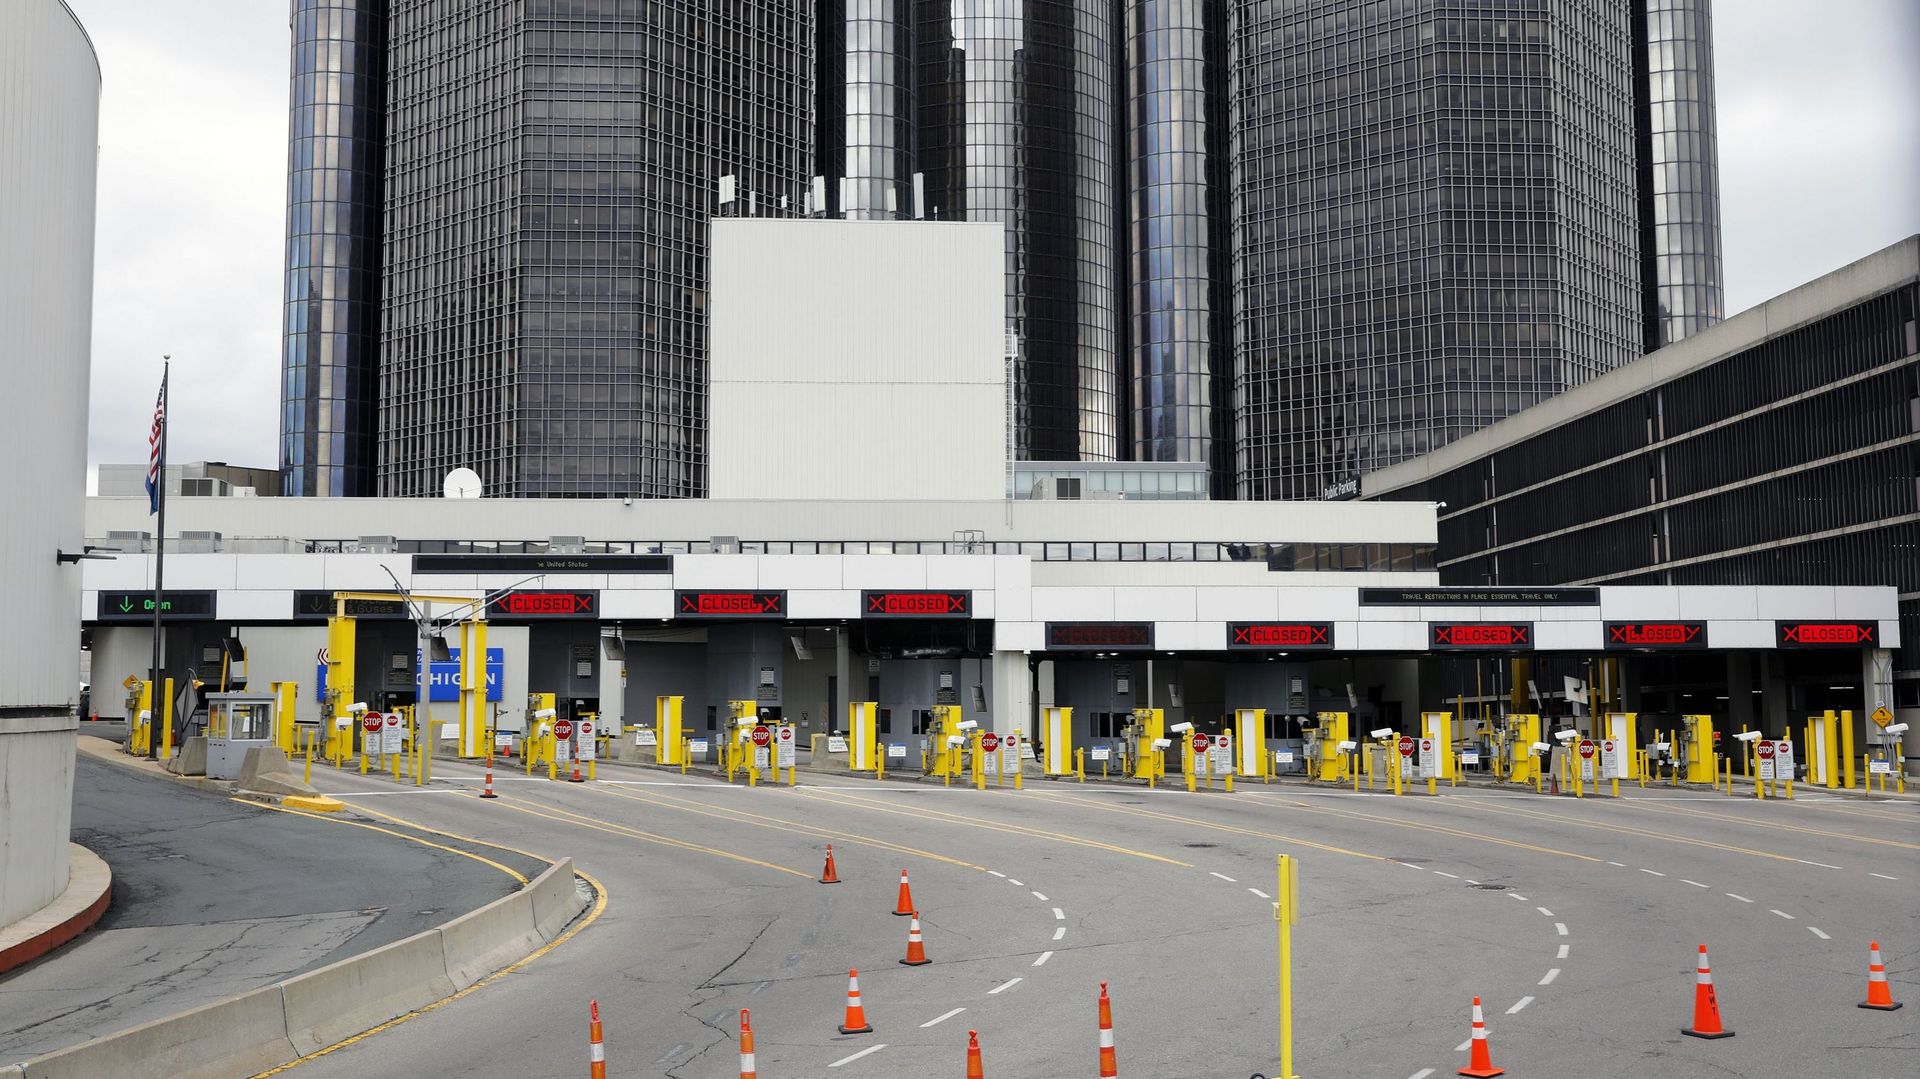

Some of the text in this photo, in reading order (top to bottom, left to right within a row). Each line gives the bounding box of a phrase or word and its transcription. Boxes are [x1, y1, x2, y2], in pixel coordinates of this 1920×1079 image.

[1324, 479, 1356, 500] Public Parking
[513, 598, 571, 610] CLOSED
[702, 598, 759, 610] CLOSED
[889, 598, 945, 610] CLOSED
[1253, 629, 1308, 641] CLOSED
[1455, 629, 1508, 641] CLOSED
[1802, 628, 1854, 640] CLOSED
[364, 718, 382, 726] STOP
[555, 725, 571, 734] STOP
[753, 732, 769, 740] STOP
[982, 738, 997, 747] STOP
[1193, 739, 1208, 748] STOP
[1399, 742, 1413, 750] STOP
[1580, 745, 1594, 753] STOP
[1758, 746, 1774, 754] STOP
